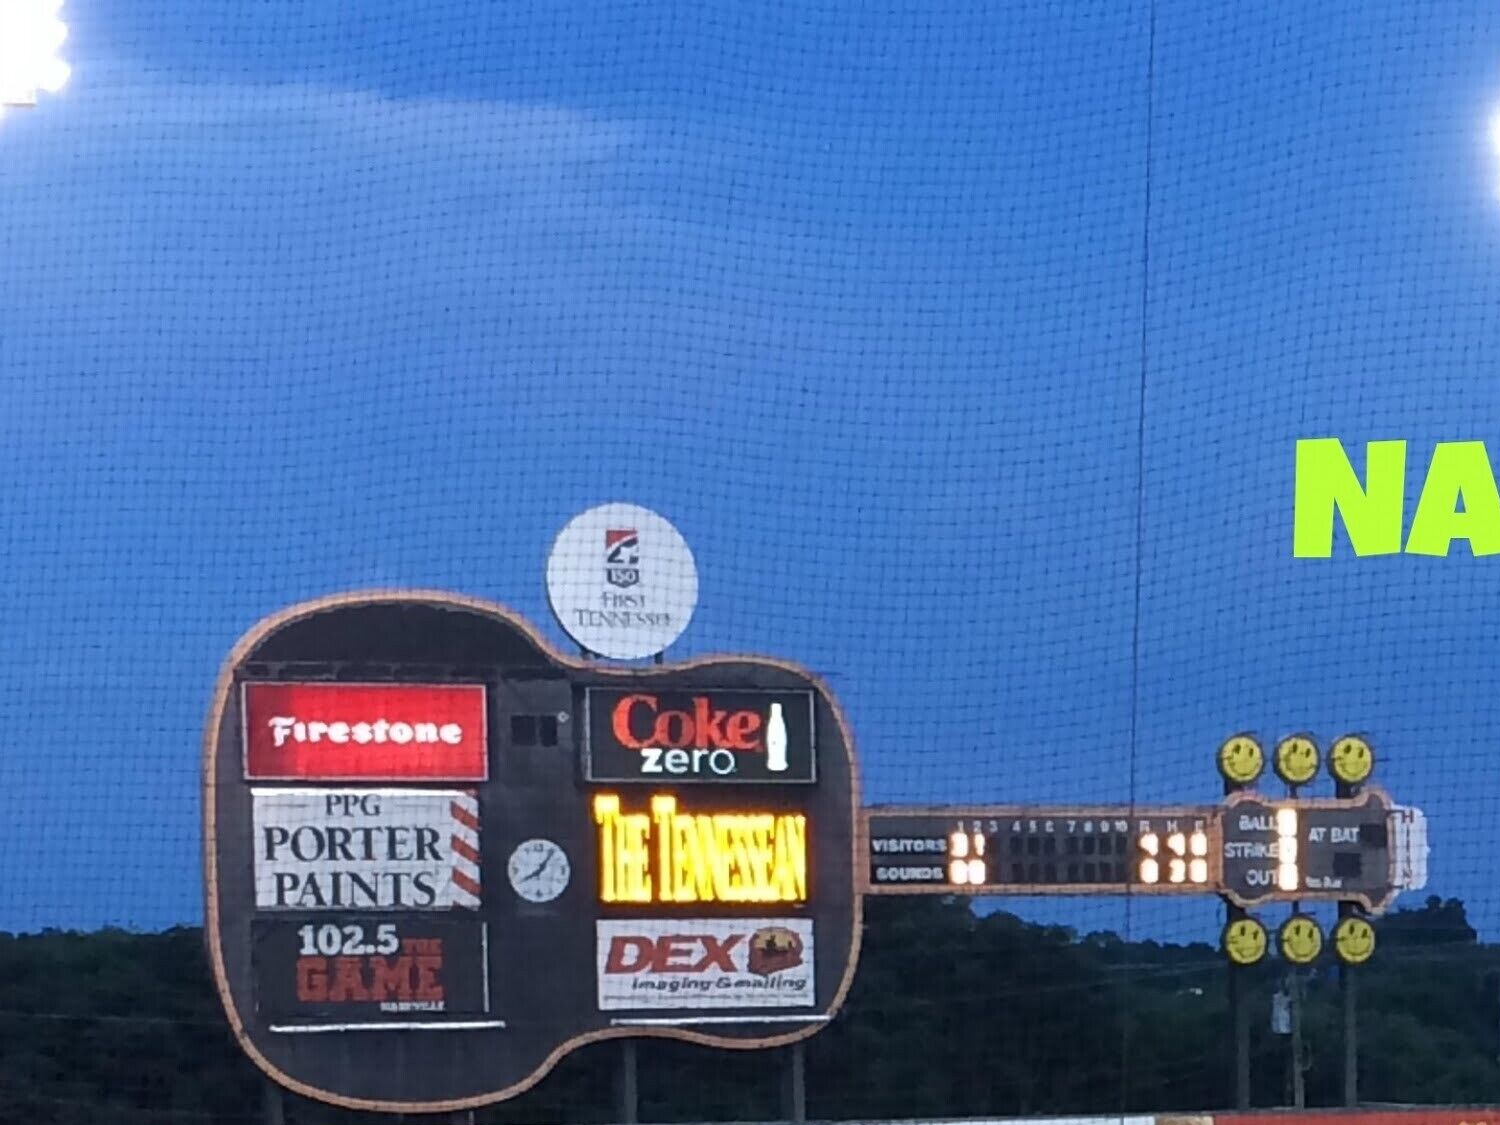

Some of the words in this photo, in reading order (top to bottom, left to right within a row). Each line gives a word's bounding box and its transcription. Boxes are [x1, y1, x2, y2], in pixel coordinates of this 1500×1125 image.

[268, 717, 462, 747] Firestone
[613, 694, 761, 749] Coke
[641, 748, 735, 774] zero
[325, 794, 382, 817] PPG
[263, 826, 444, 862] PORTER
[594, 795, 651, 902] THE
[652, 795, 806, 902] TENNESSEAN
[872, 839, 946, 852] VISITORS
[1309, 827, 1326, 841] AT
[1331, 827, 1360, 842] BAT
[273, 870, 436, 907] PAINTS
[876, 867, 943, 880] SOUNDS
[298, 924, 399, 955] 102.5
[605, 934, 746, 973] DEX
[297, 956, 445, 1001] GAME
[632, 977, 711, 992] imaging
[734, 975, 808, 990] mailing
